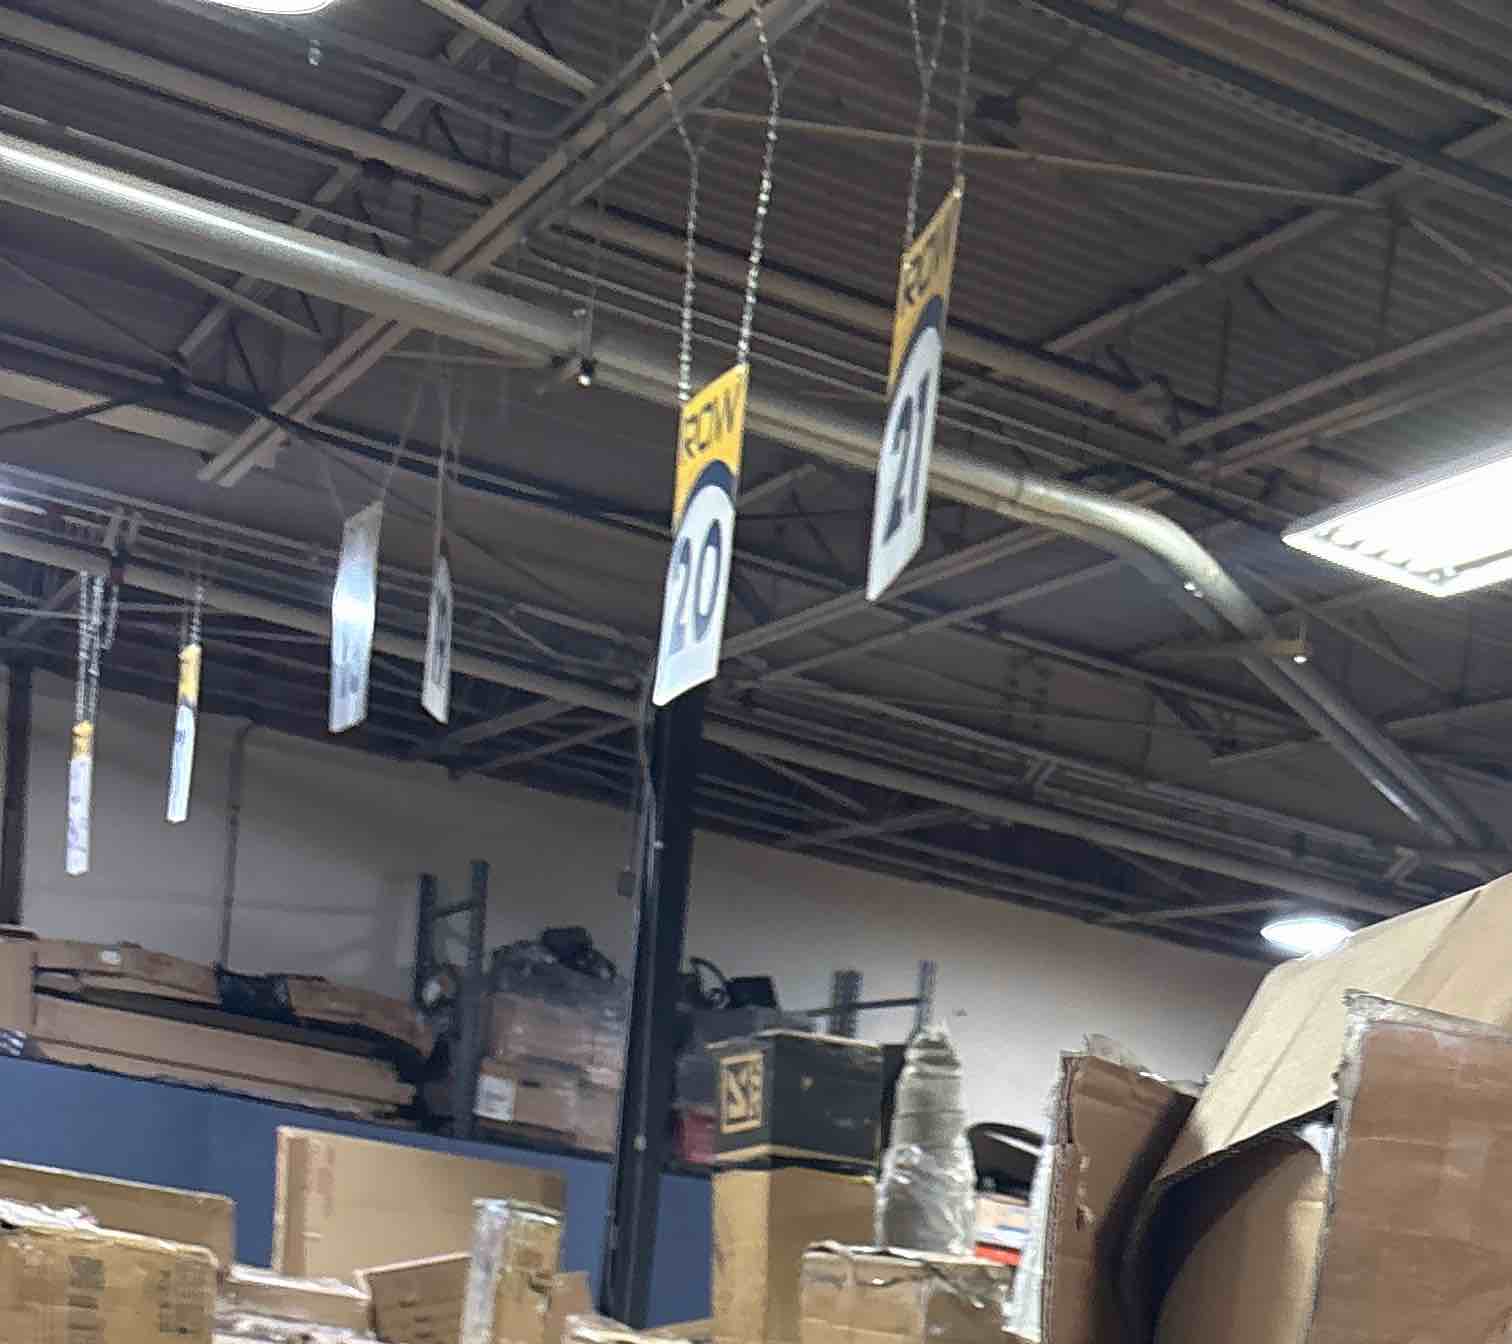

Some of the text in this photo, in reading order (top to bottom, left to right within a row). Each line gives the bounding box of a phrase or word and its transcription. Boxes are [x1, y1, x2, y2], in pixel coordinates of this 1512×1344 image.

[683, 384, 739, 457] ROW
[883, 370, 931, 545] 21
[667, 519, 722, 656] 20
